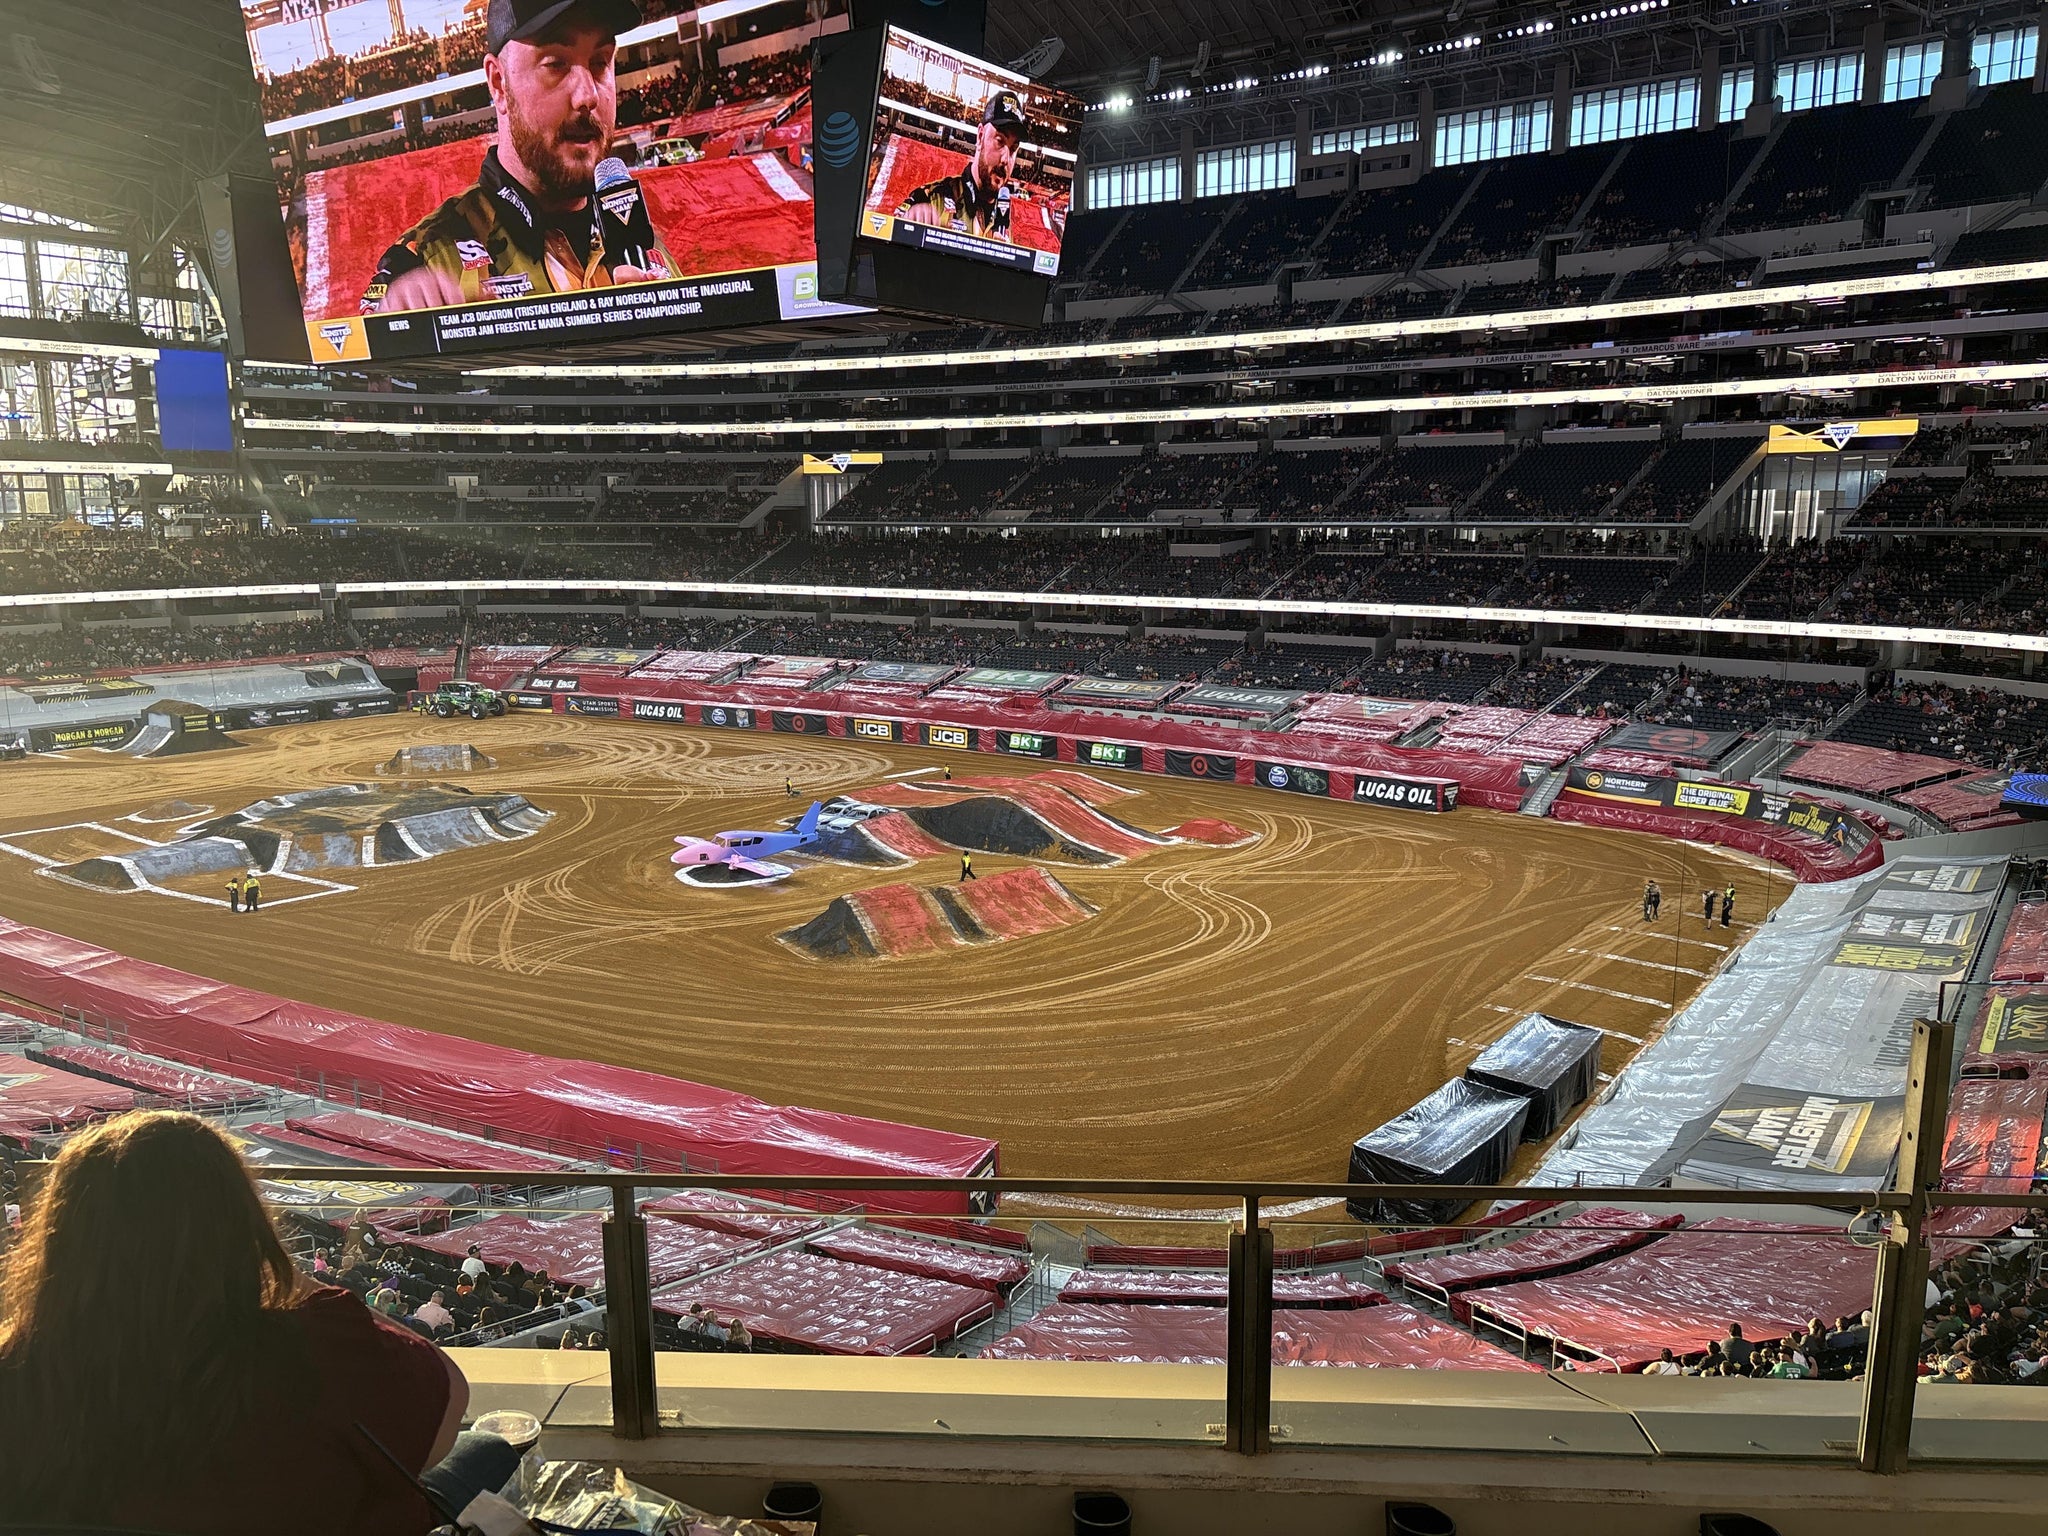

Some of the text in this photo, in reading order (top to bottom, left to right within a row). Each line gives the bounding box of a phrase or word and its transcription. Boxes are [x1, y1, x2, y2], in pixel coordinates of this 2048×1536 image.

[906, 41, 964, 74] AT&T STADIUM
[497, 186, 533, 228] MONSTER
[601, 193, 638, 211] MONSTER
[612, 203, 632, 214] JAM
[464, 255, 494, 270] SIMPSON
[439, 280, 754, 326] TEAM JCB DIGATRON (TRISTAN ENGLAND & RAY NOREIGA) WON THE INAUGURAL
[388, 320, 410, 331] NEWS
[441, 302, 703, 339] MONSTER JAM FREESTYLE MANIA SUMMER SERIES CHAMPIONSHIP.
[320, 327, 352, 338] MONSTER
[330, 335, 346, 344] JAM
[1676, 341, 1700, 350] WARE
[1485, 355, 1509, 363] LARRY
[1354, 363, 1379, 371] EMMITT
[1877, 373, 1956, 384] DALTON WIDNER
[1646, 388, 1678, 396] DALTON
[1824, 427, 1859, 435] MONSTER
[974, 670, 1048, 683] BKT
[1081, 681, 1128, 691] JCB
[1192, 689, 1291, 705] LUCAS OIL
[635, 703, 665, 718] LUCAS
[55, 726, 124, 742] MORGAN & MORGAN
[859, 723, 890, 737] JCB
[933, 730, 965, 744] JCB
[1010, 734, 1042, 749] BKT
[1091, 745, 1126, 760] BKT
[1605, 777, 1648, 788] NORTHERN
[1357, 780, 1406, 801] LUCAS
[1681, 787, 1735, 801] THE ORIGINAL
[1679, 795, 1729, 808] SUPER GLUE
[1762, 798, 1789, 809] MONSTER
[1807, 805, 1820, 818] THE
[1787, 811, 1811, 827] VIDEO
[1806, 817, 1831, 835] GAME
[1909, 870, 1936, 886] JAM
[1929, 865, 1961, 891] MONSTER
[1900, 919, 1927, 936] JAM
[1920, 913, 1954, 944] MONSTER
[1833, 943, 1884, 966] GAME
[1746, 1109, 1791, 1149] JAM
[1771, 1096, 1840, 1169] MONSTER
